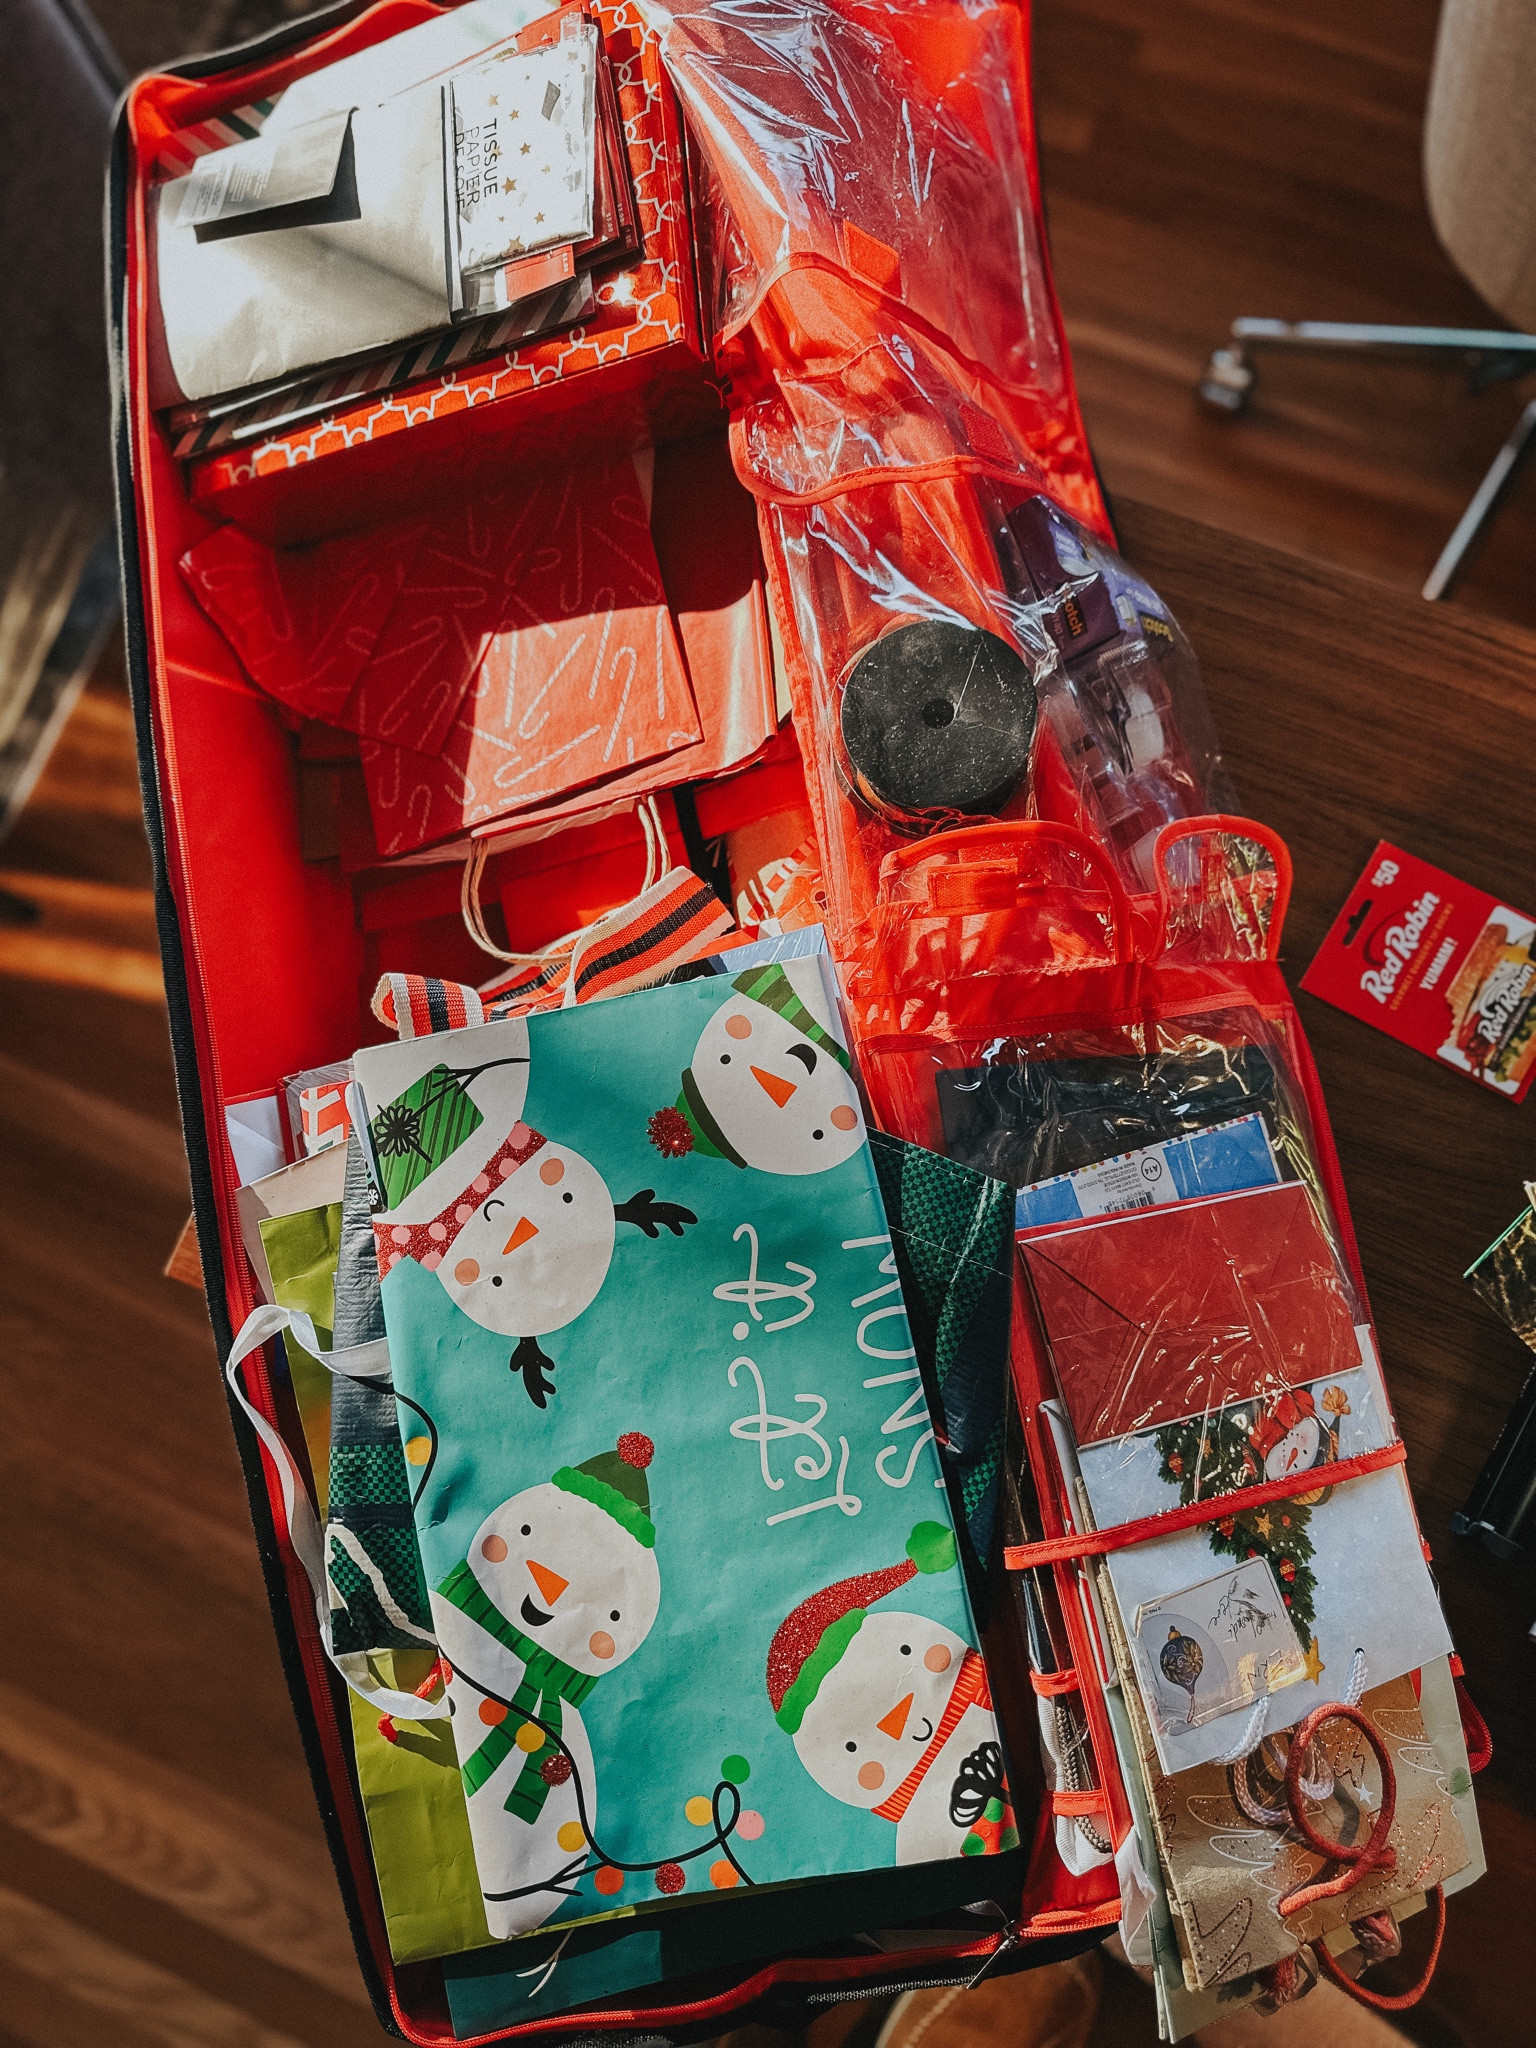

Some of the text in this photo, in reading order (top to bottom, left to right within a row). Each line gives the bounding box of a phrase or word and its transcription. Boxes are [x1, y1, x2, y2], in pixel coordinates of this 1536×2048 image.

[466, 126, 480, 207] PAPIER
[484, 118, 498, 198] TISSUE
[1371, 859, 1400, 887] $50
[1360, 891, 1441, 1004] Red Robin
[1419, 936, 1458, 991] YUMMM!
[1477, 999, 1512, 1044] Red
[1496, 961, 1535, 1013] Robin
[1145, 1164, 1158, 1175] A14
[712, 1223, 863, 1527] Let it
